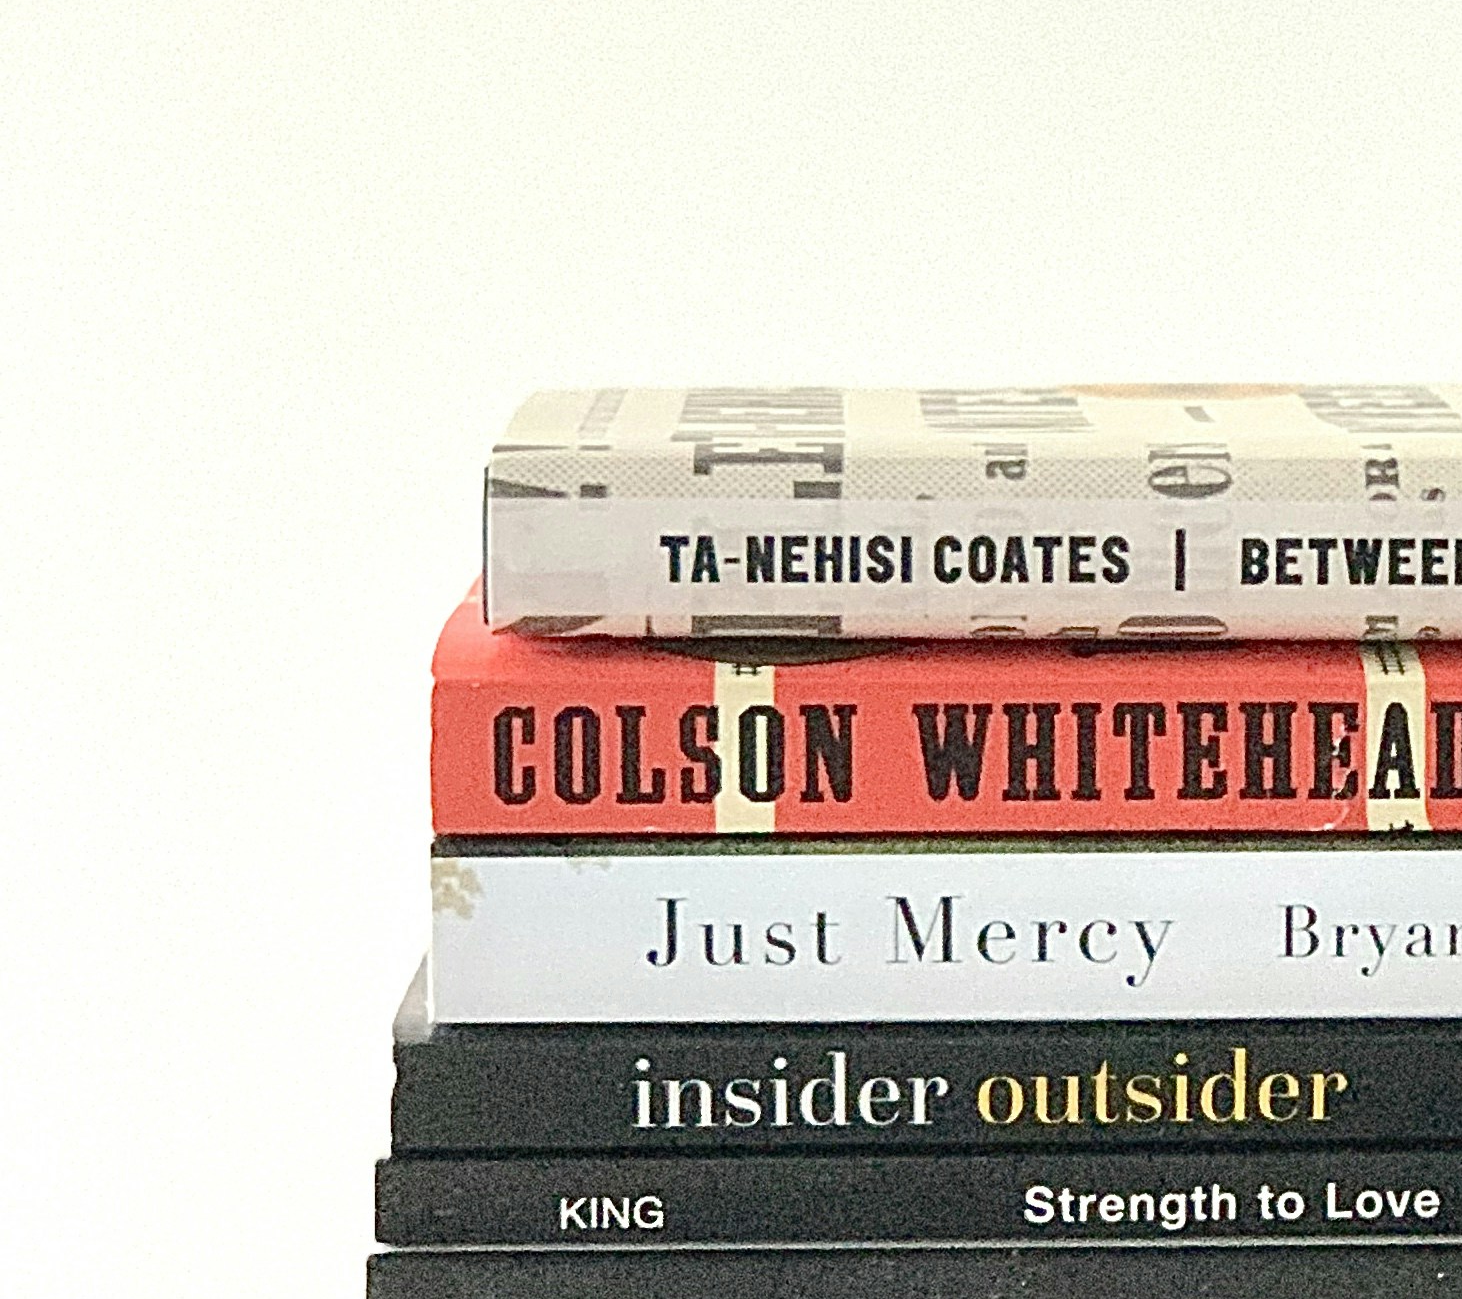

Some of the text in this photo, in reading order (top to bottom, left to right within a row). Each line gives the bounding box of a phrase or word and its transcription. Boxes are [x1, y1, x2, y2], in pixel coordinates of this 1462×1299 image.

[659, 535, 1130, 584] TA-NEHISI COATES
[493, 704, 857, 805] COLSON
[645, 895, 1176, 988] Just Mercy
[632, 1047, 1349, 1129] insider outsider
[559, 1195, 664, 1230] KING
[1024, 1182, 1440, 1231] Strength to Love
